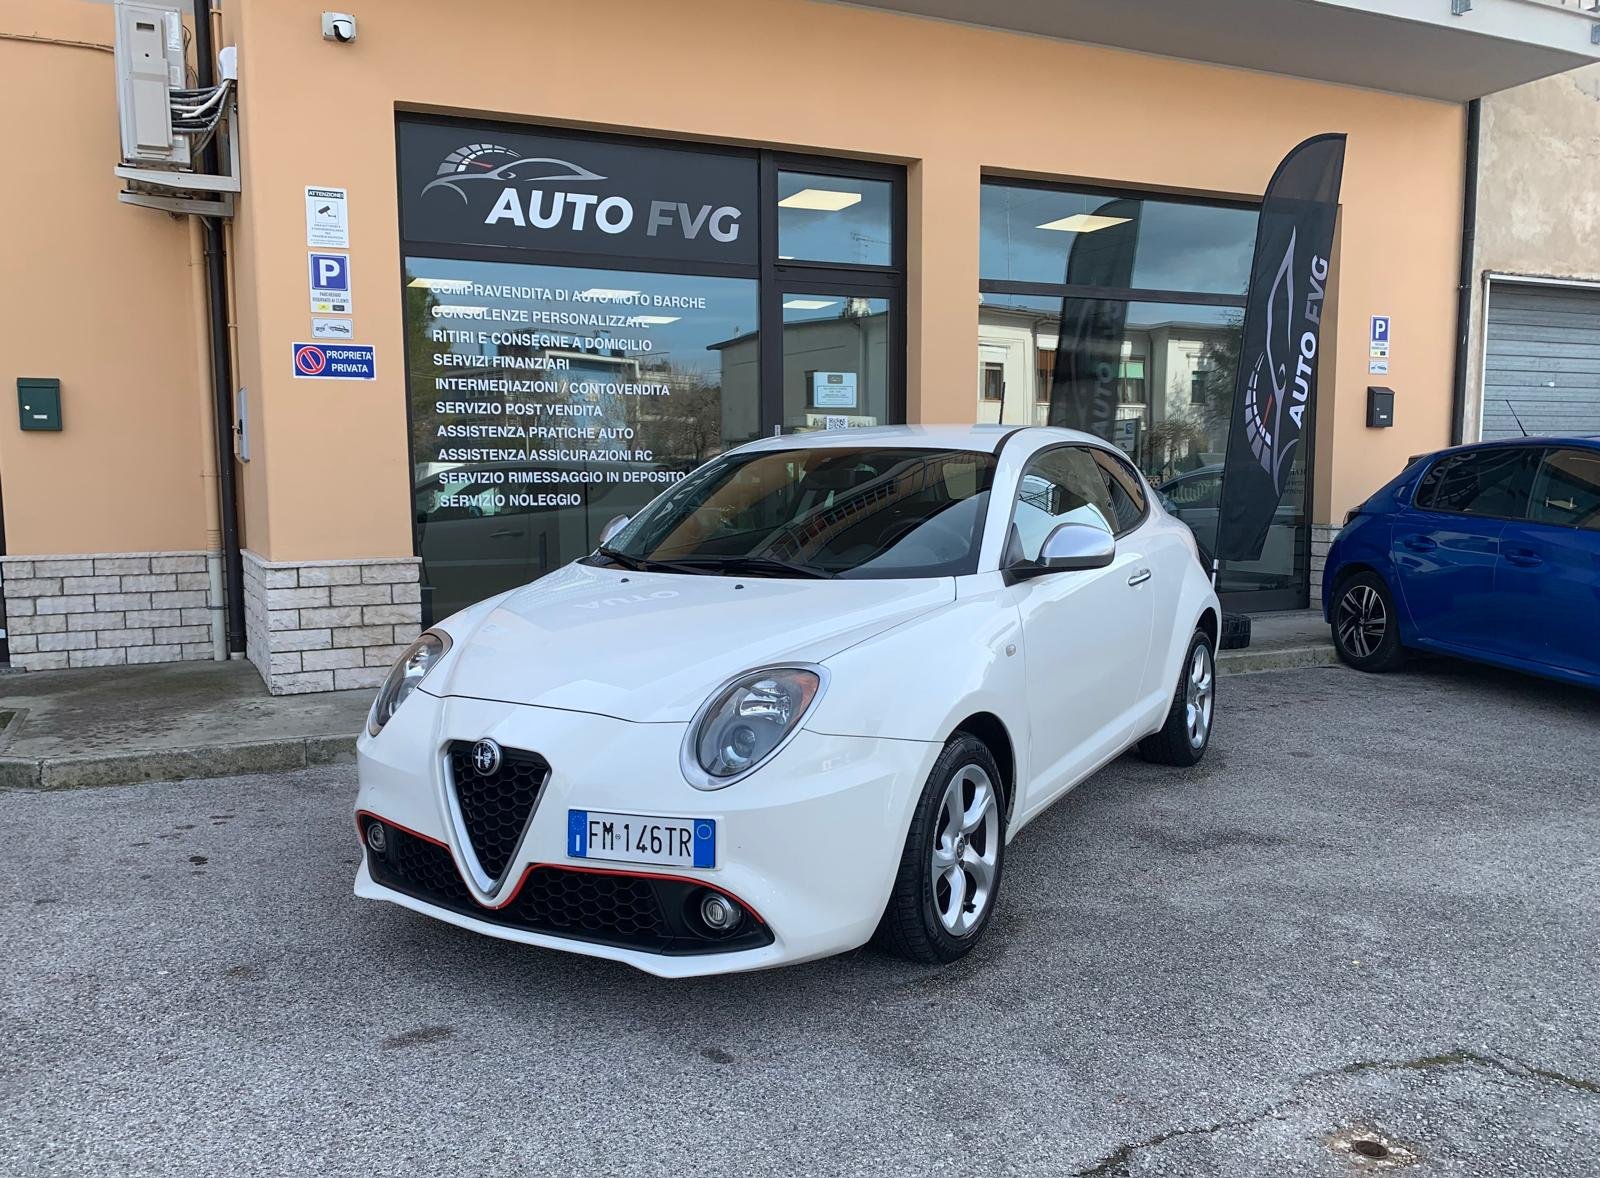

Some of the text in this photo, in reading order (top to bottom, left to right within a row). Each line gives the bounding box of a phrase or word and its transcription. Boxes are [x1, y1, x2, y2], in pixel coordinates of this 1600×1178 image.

[484, 187, 742, 243] AUTO FVG
[319, 258, 340, 286] P
[430, 281, 706, 309] COMPRAVENDITA DI AUTO MOTO BARCHE
[431, 305, 650, 329] CONSULENZE PERSONALIZZATE
[1375, 319, 1386, 339] P
[432, 329, 653, 351] RITIRI E CONSEGNE A DOMICILIO
[1288, 254, 1330, 430] AUTO FVG
[326, 350, 373, 361] PROPRIETA'
[433, 353, 570, 370] SERVIZI FINANZIARI
[331, 363, 369, 373] PRIVATA
[435, 378, 558, 393] INTERMEDIAZIONI
[569, 382, 671, 396] CONTOVENDITA
[435, 401, 603, 417] SERVIZIO POST VENDITA
[437, 425, 634, 439] ASSISTENZA PRATICHE AUTO
[438, 448, 653, 461] ASSISTENZA ASSICURAZIONI RC
[439, 471, 685, 484] SERVIZIO RIMESSAGGIO IN DEPOSITO
[440, 493, 581, 508] SERVIZIO NOLEGGIO
